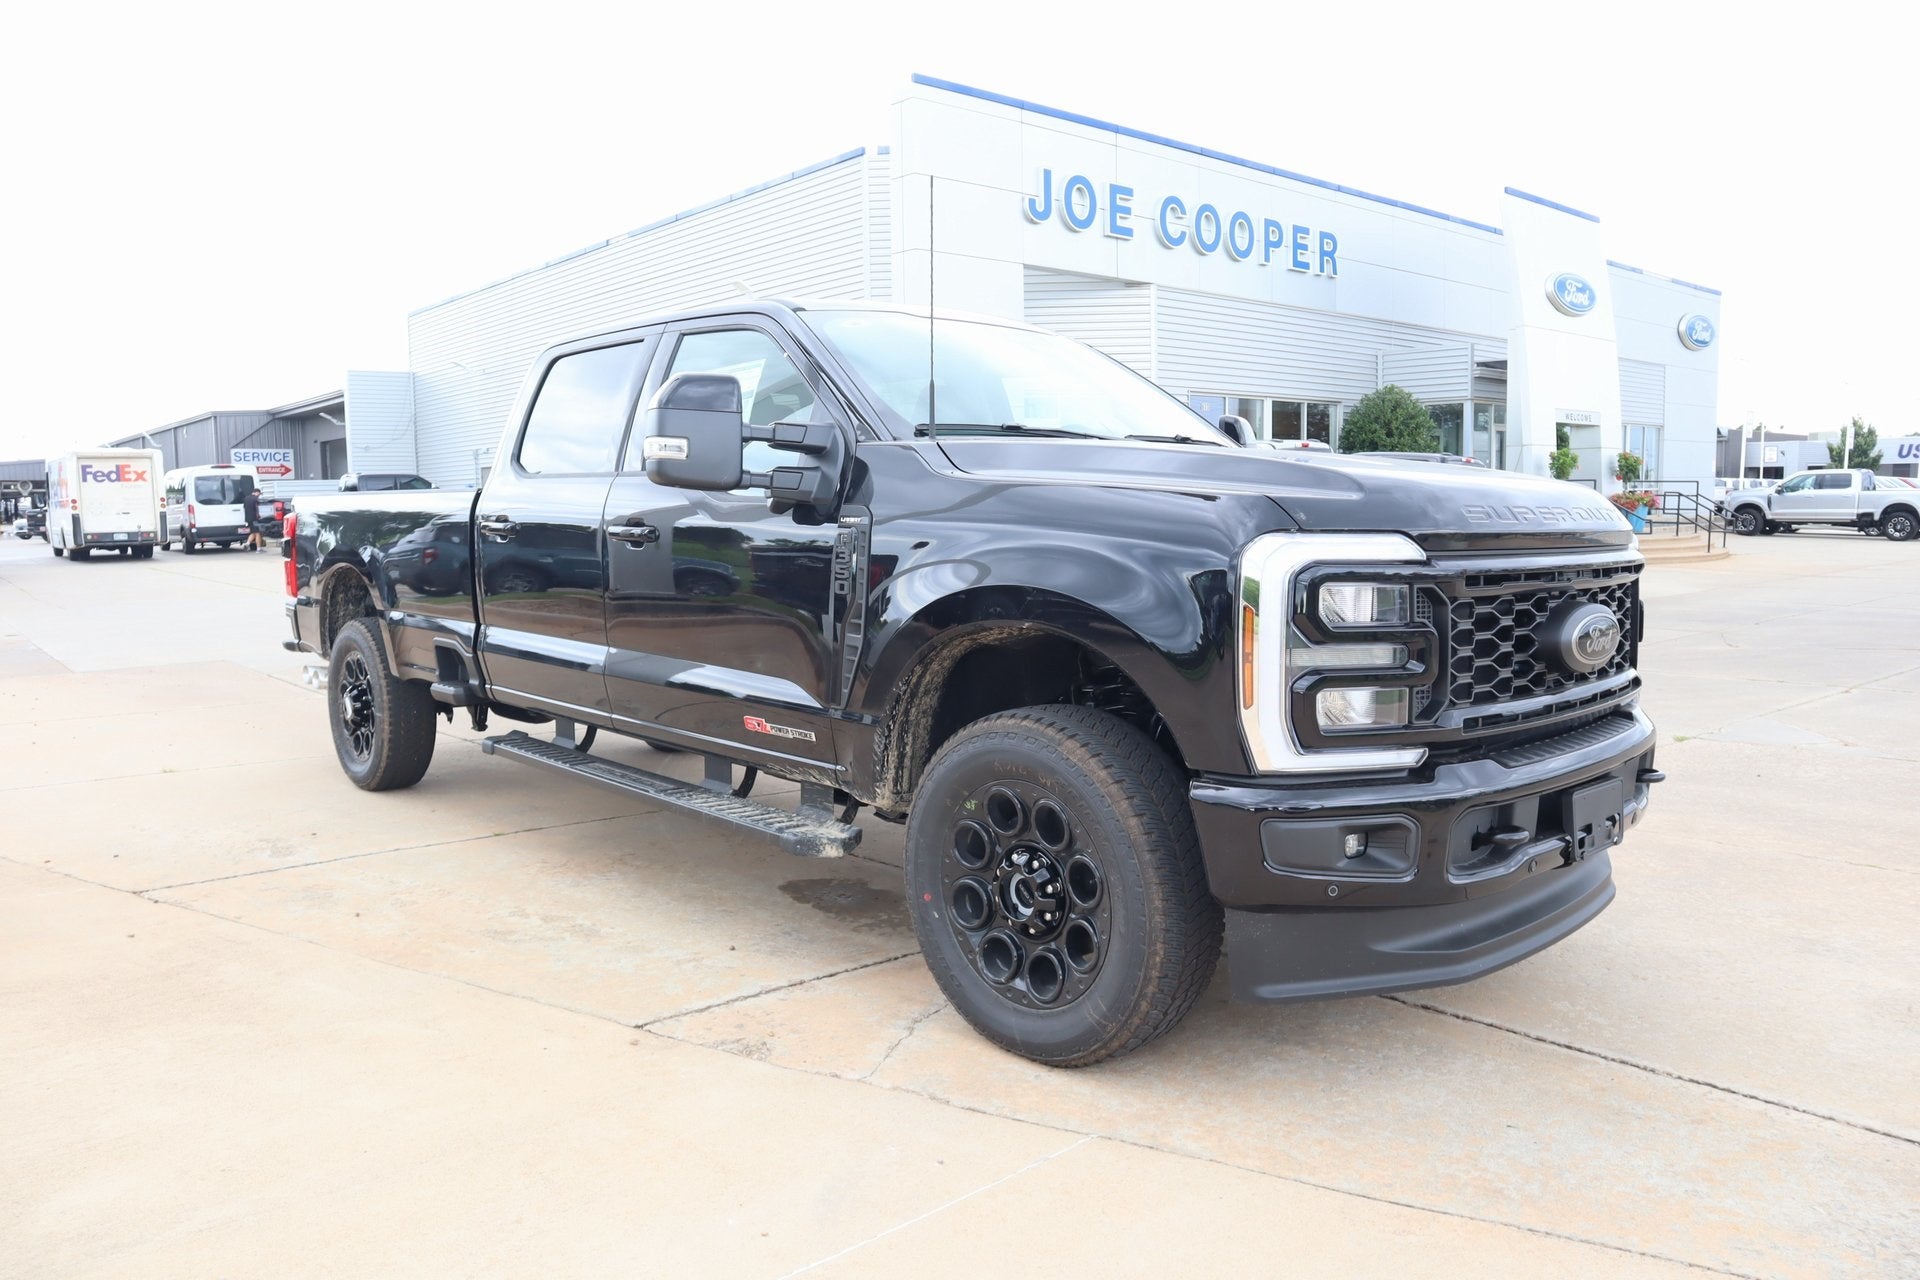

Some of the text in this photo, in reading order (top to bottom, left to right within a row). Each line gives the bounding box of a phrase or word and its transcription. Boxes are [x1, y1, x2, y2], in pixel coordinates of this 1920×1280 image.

[1024, 168, 1340, 279] JOE COOPER
[1564, 279, 1591, 306] Ford
[1691, 319, 1712, 341] Ford
[1565, 413, 1593, 423] WELCOME
[233, 451, 291, 463] SERVICE
[81, 464, 149, 483] FedEx
[1586, 625, 1614, 653] Ford
[770, 726, 790, 735] POWER
